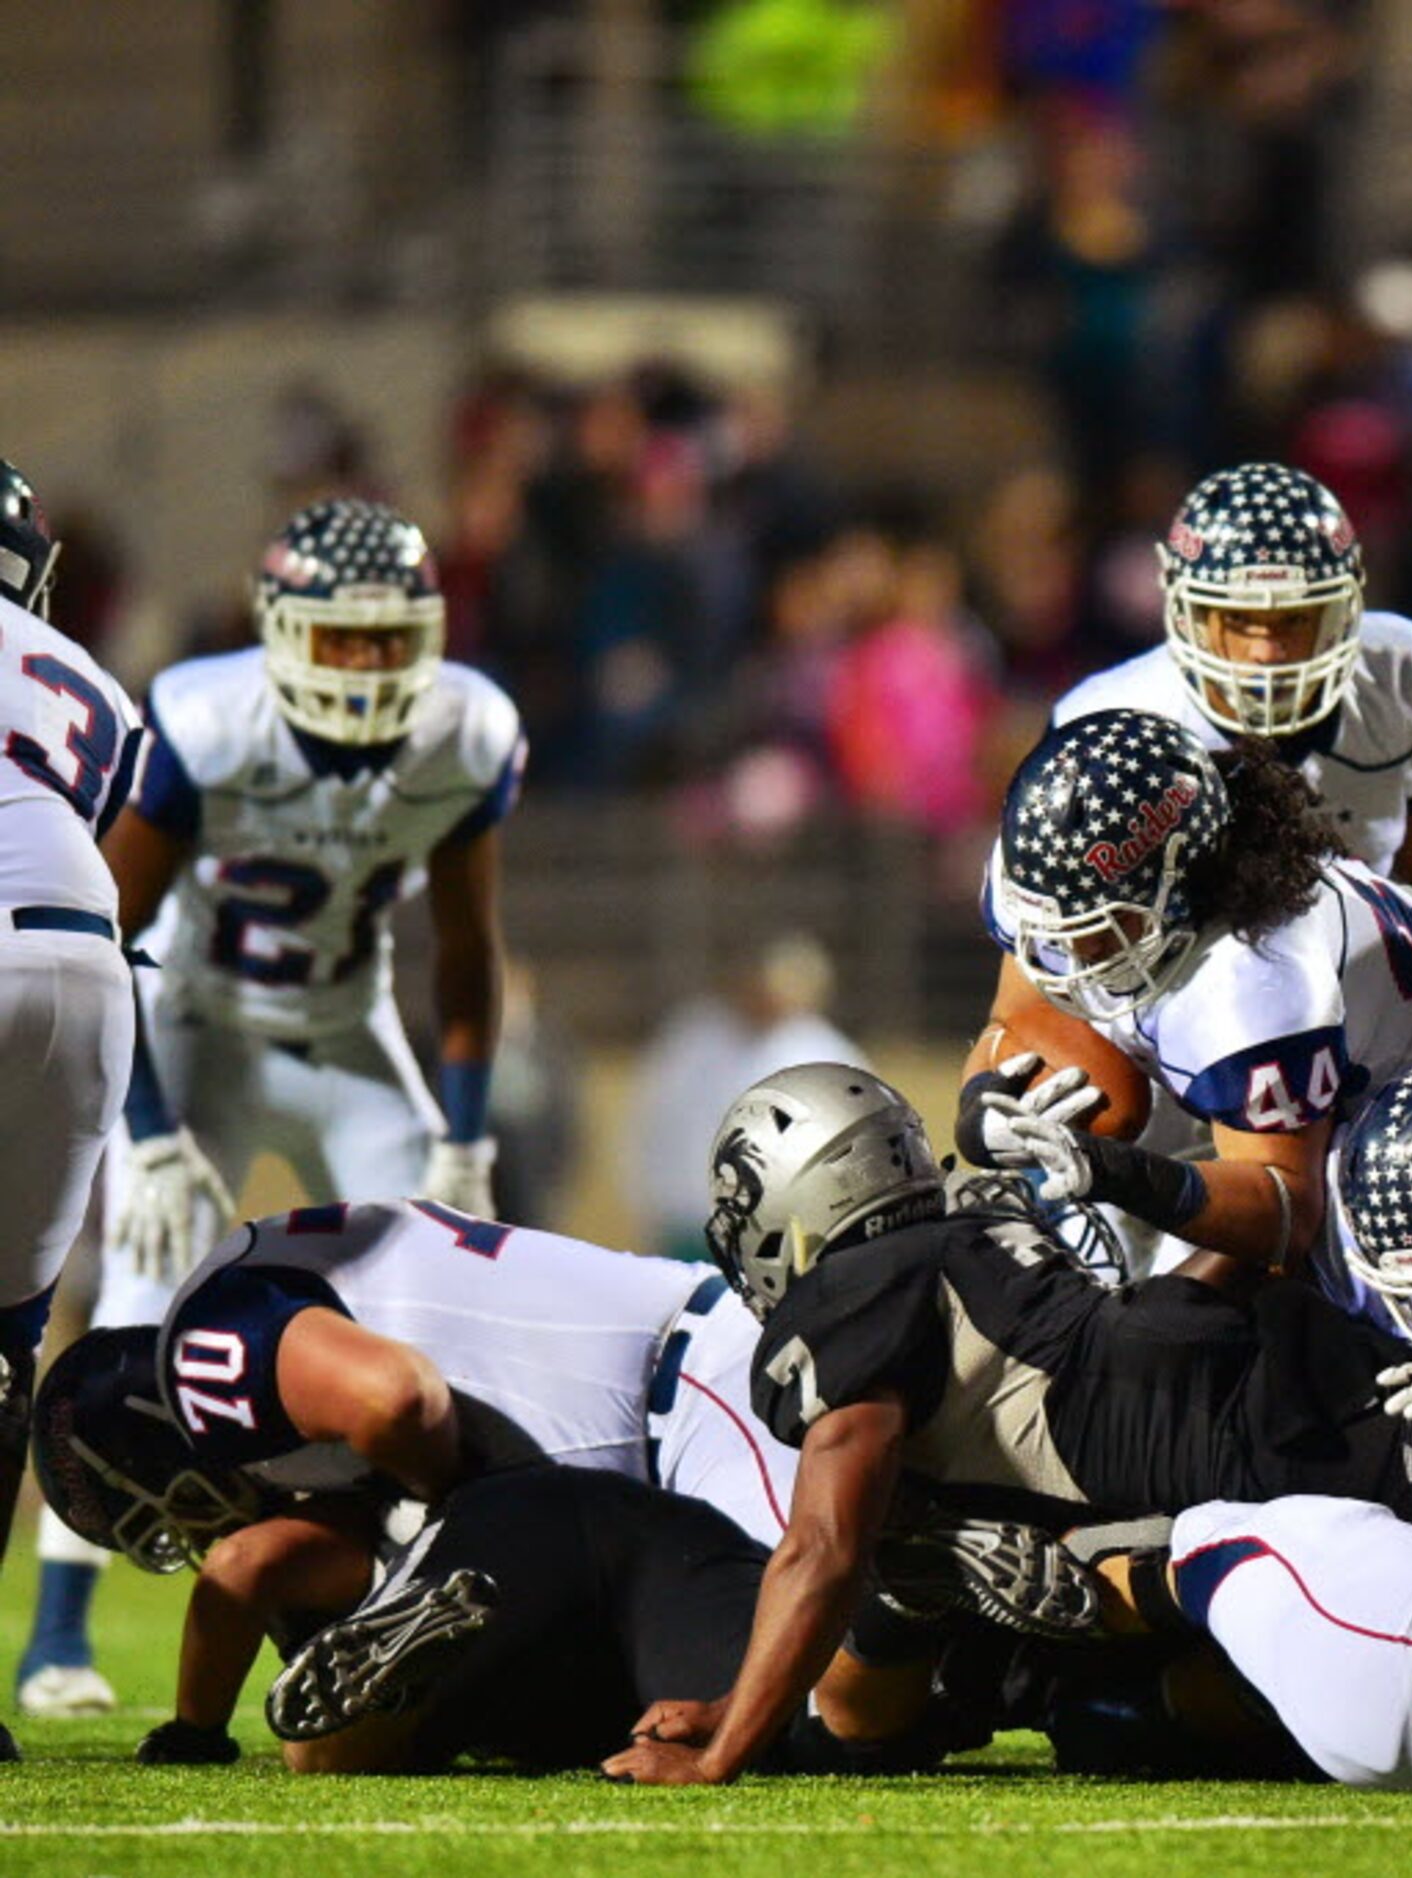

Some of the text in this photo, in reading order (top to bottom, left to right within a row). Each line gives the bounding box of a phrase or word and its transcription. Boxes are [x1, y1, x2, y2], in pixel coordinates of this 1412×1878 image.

[1244, 1043, 1343, 1133] 44
[172, 1326, 259, 1435] 70
[765, 1333, 830, 1425] 7
